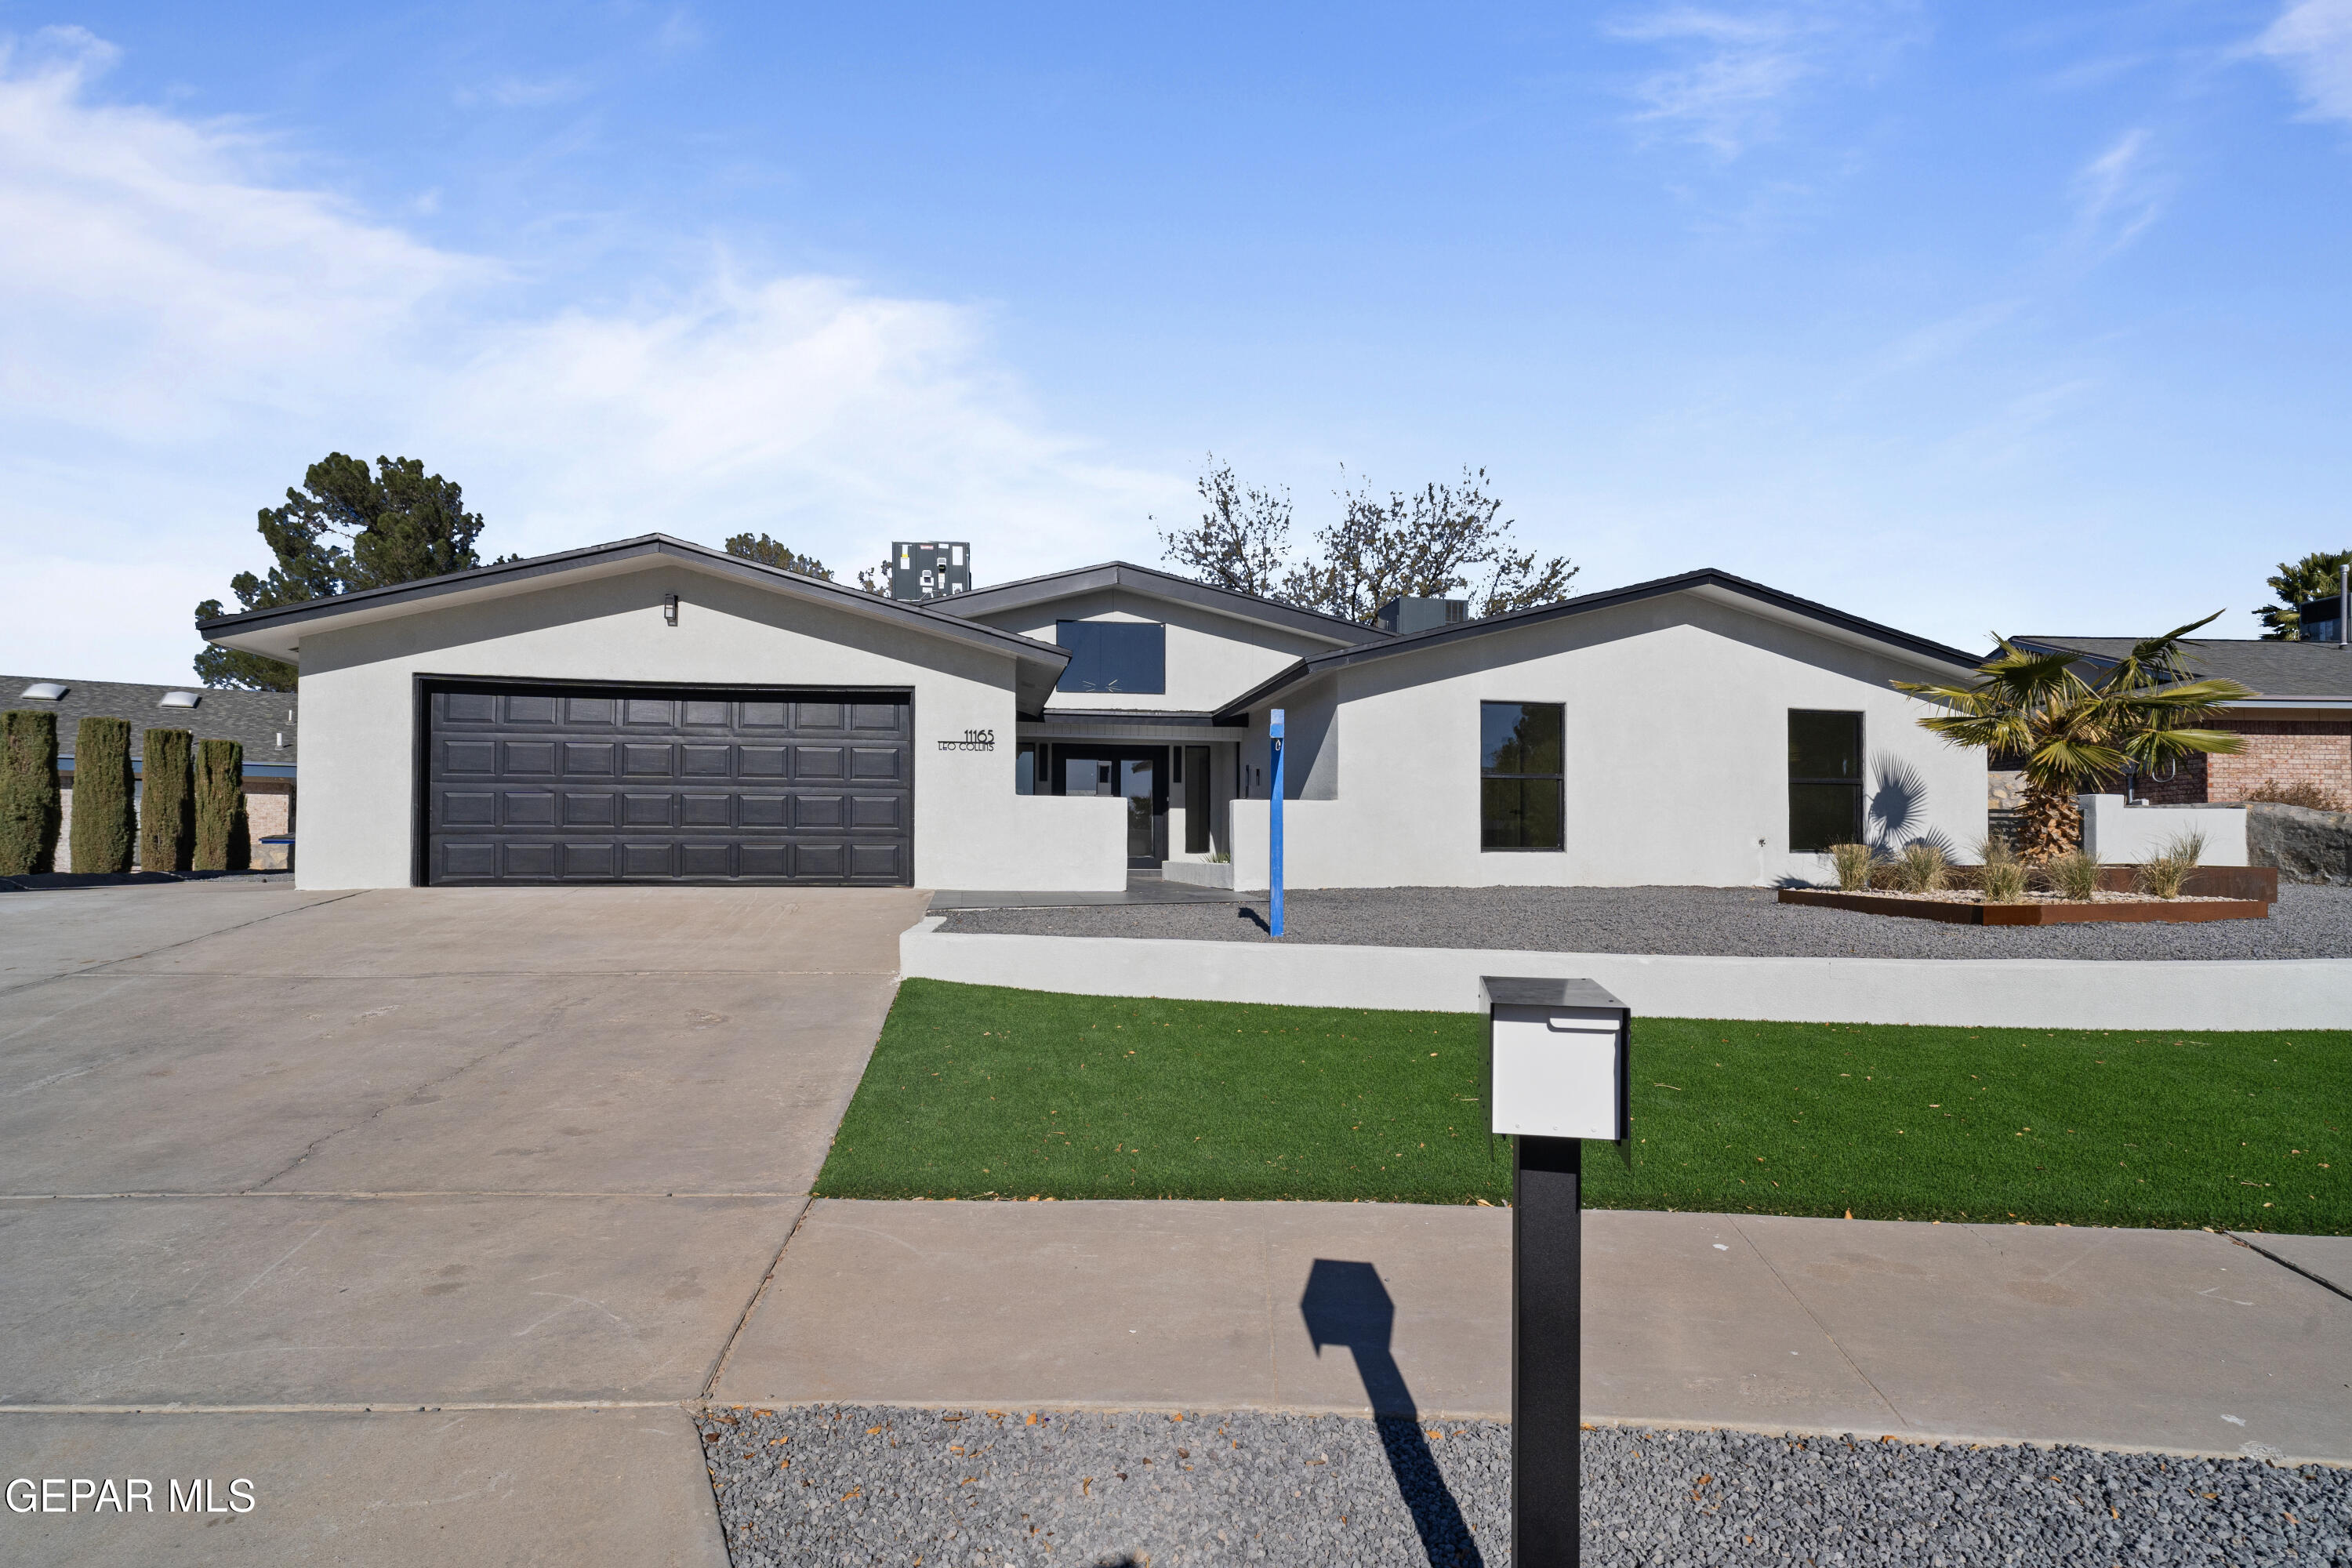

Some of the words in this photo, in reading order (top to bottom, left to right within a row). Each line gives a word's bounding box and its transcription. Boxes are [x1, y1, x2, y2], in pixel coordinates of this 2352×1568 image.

[964, 729, 994, 742] 11165
[938, 742, 956, 750] LEO
[959, 742, 994, 752] COLLINS
